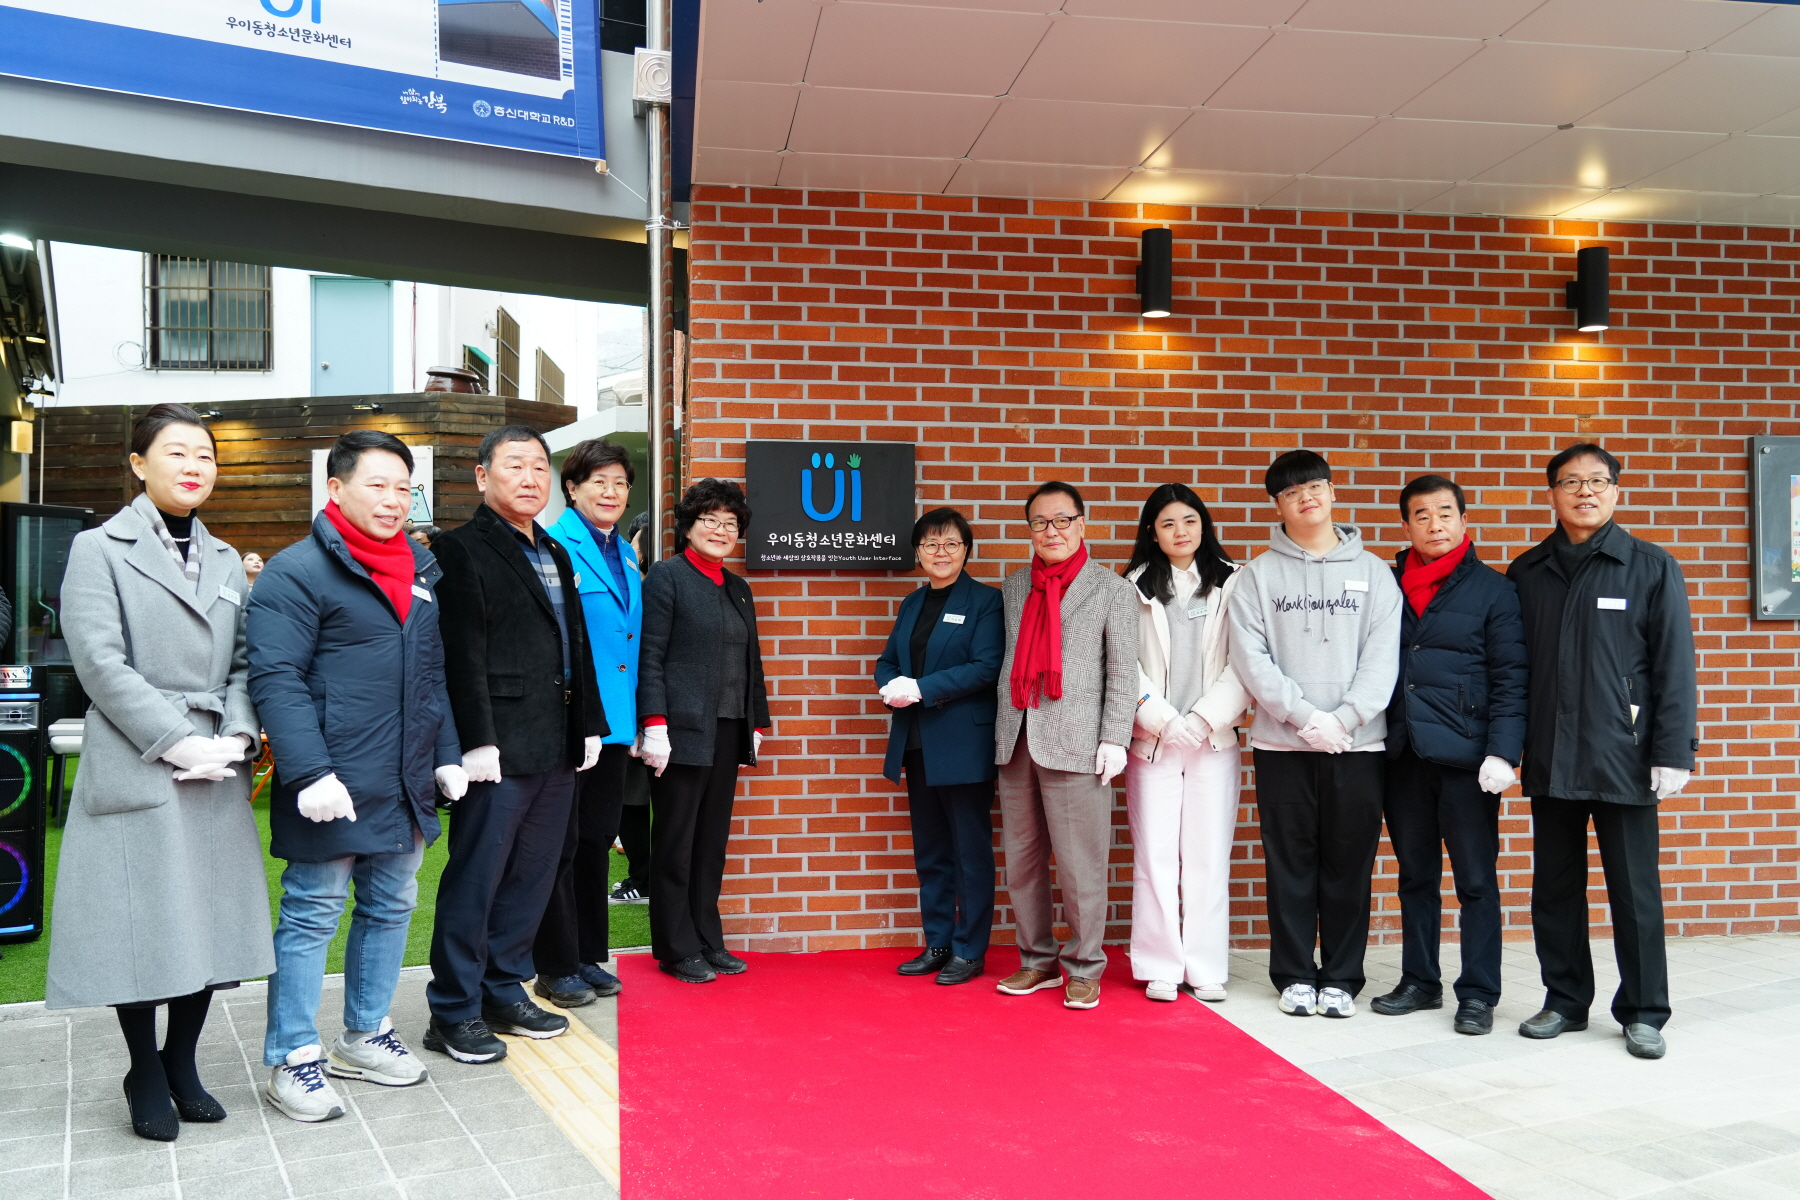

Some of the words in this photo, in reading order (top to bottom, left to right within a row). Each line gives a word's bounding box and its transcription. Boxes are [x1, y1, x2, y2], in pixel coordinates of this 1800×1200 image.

[226, 16, 352, 49] 우이동청소년문화센터
[422, 91, 448, 114] 강북
[553, 115, 575, 128] R&D
[767, 531, 896, 549] 우이동청소년문화센터
[783, 554, 799, 562] 세상의
